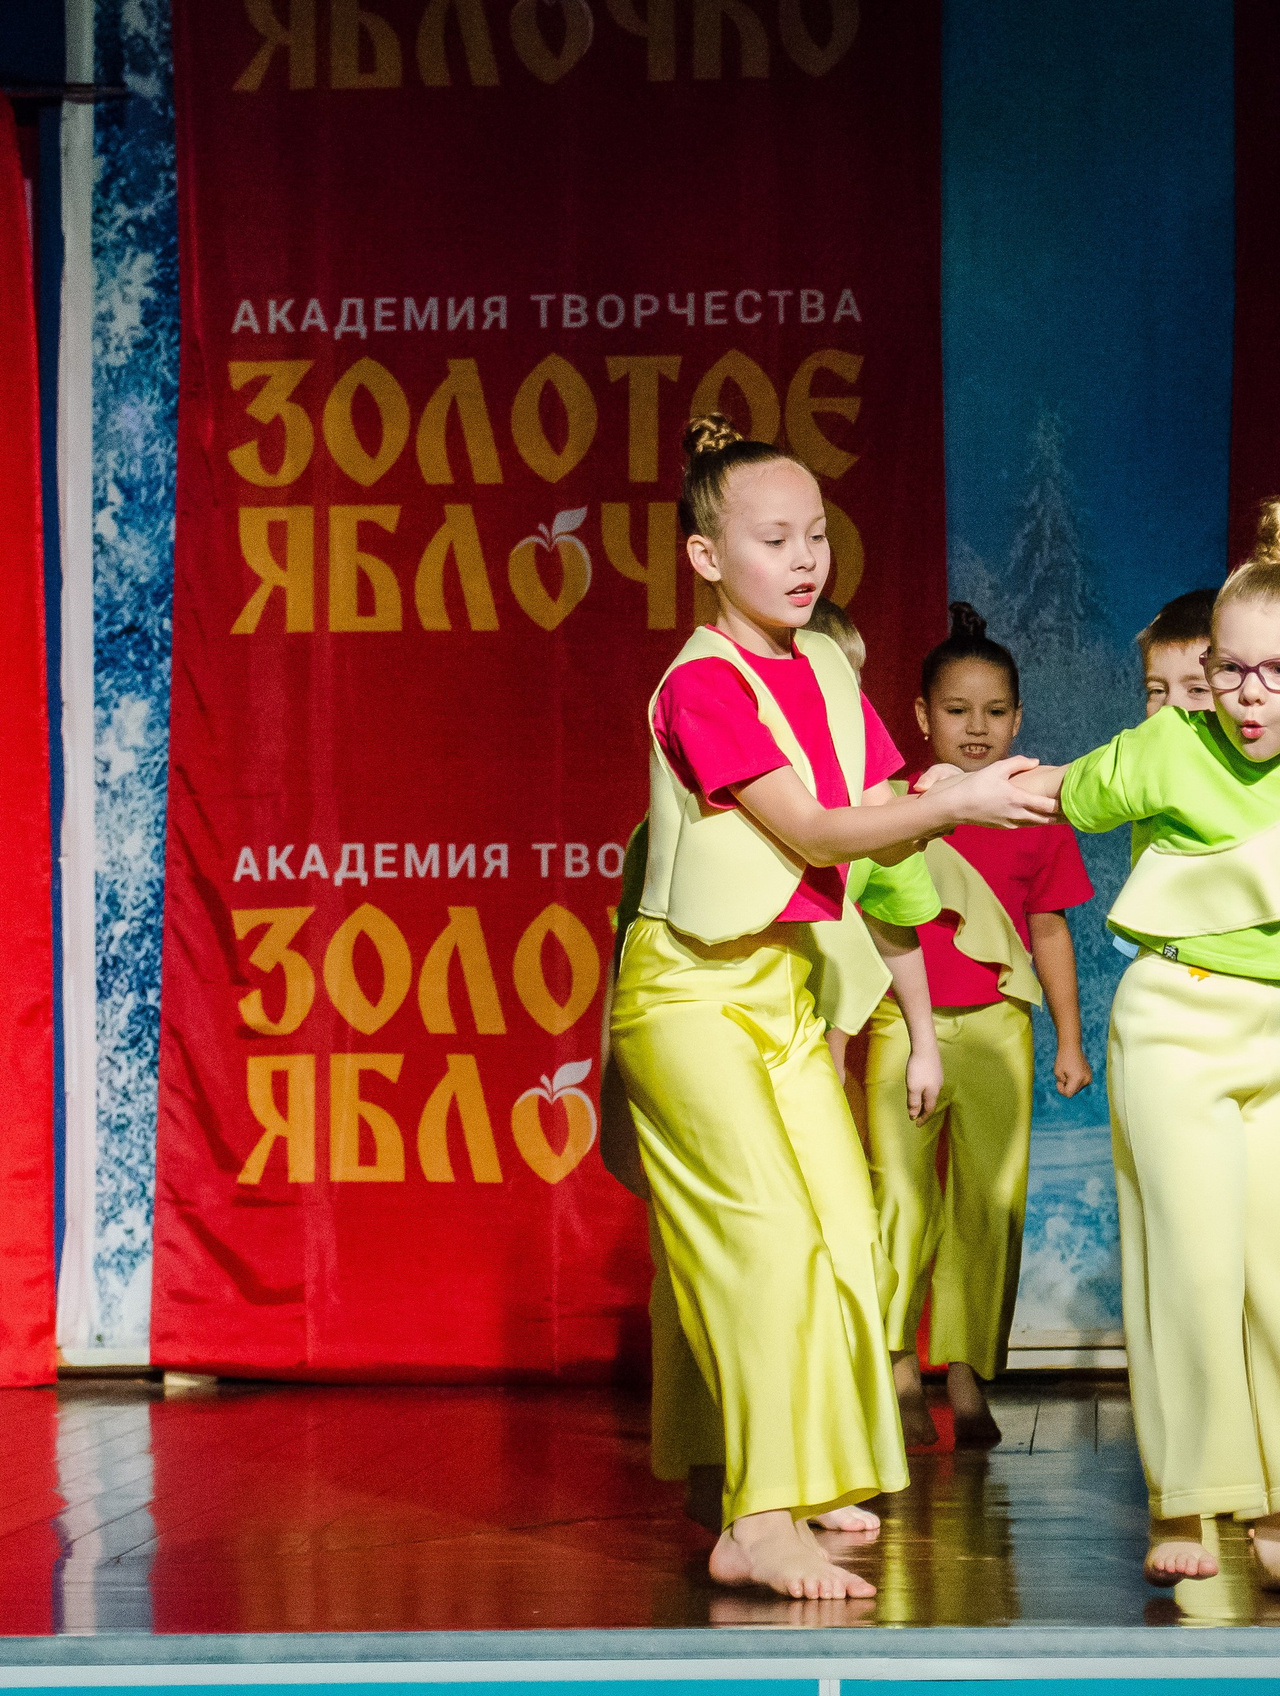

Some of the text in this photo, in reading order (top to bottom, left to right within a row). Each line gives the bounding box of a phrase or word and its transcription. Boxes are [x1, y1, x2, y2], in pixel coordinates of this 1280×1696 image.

[230, 288, 863, 340] АКАДЕМИЯ ТВОРЧЕСТВА
[226, 348, 864, 488] ЗОЛОТОЕ
[232, 842, 510, 886] АКАДЕМИЯ
[230, 901, 617, 1036] ЗОЛО
[236, 1052, 598, 1185] ЯБЛО
